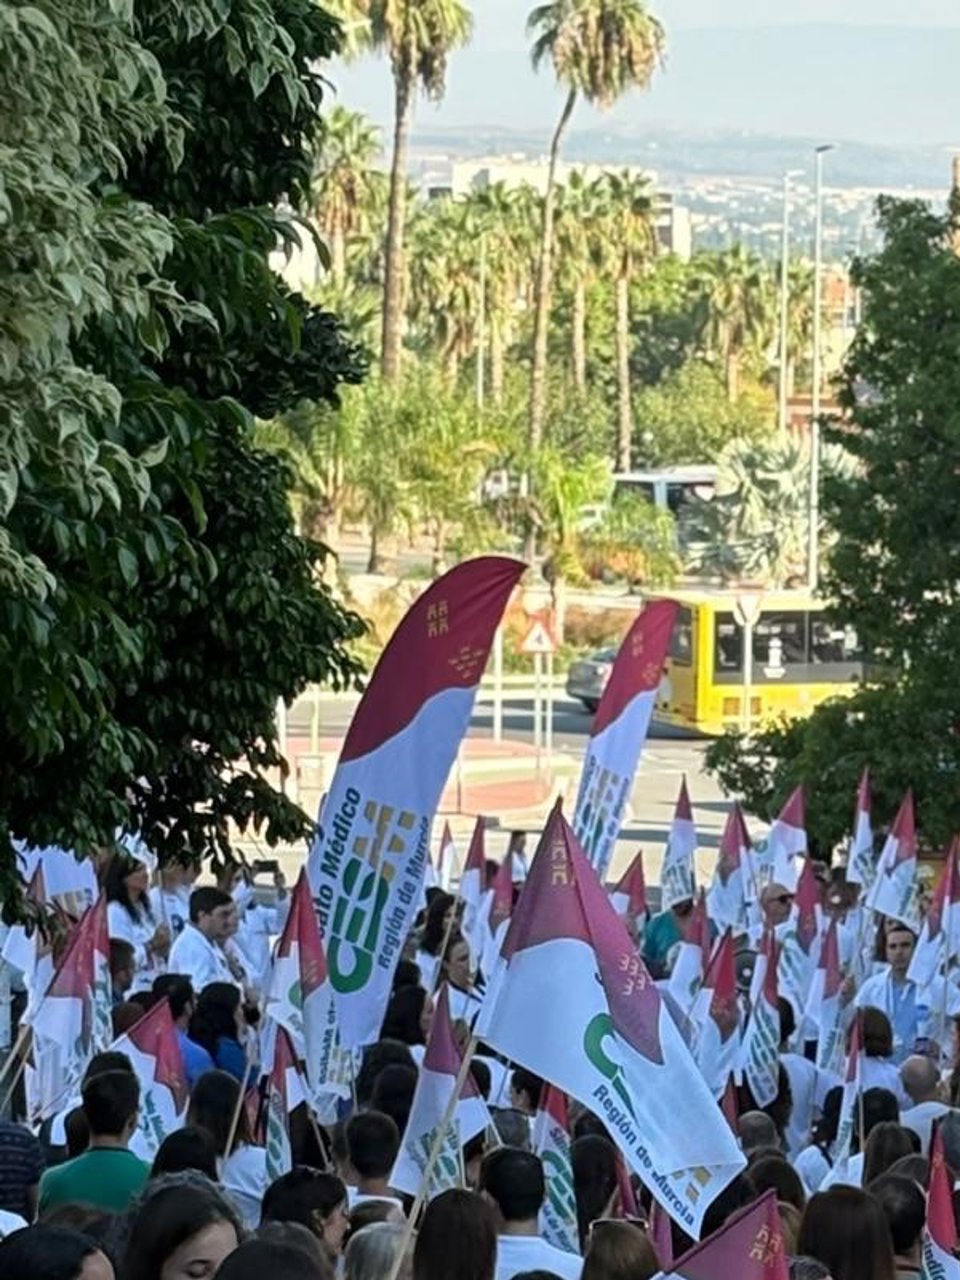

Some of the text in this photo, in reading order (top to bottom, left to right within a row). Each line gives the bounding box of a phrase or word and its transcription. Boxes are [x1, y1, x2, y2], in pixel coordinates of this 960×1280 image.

[321, 787, 361, 883] Médico
[379, 906, 407, 970] Región
[406, 815, 430, 880] Murcia
[592, 1084, 637, 1146] Región
